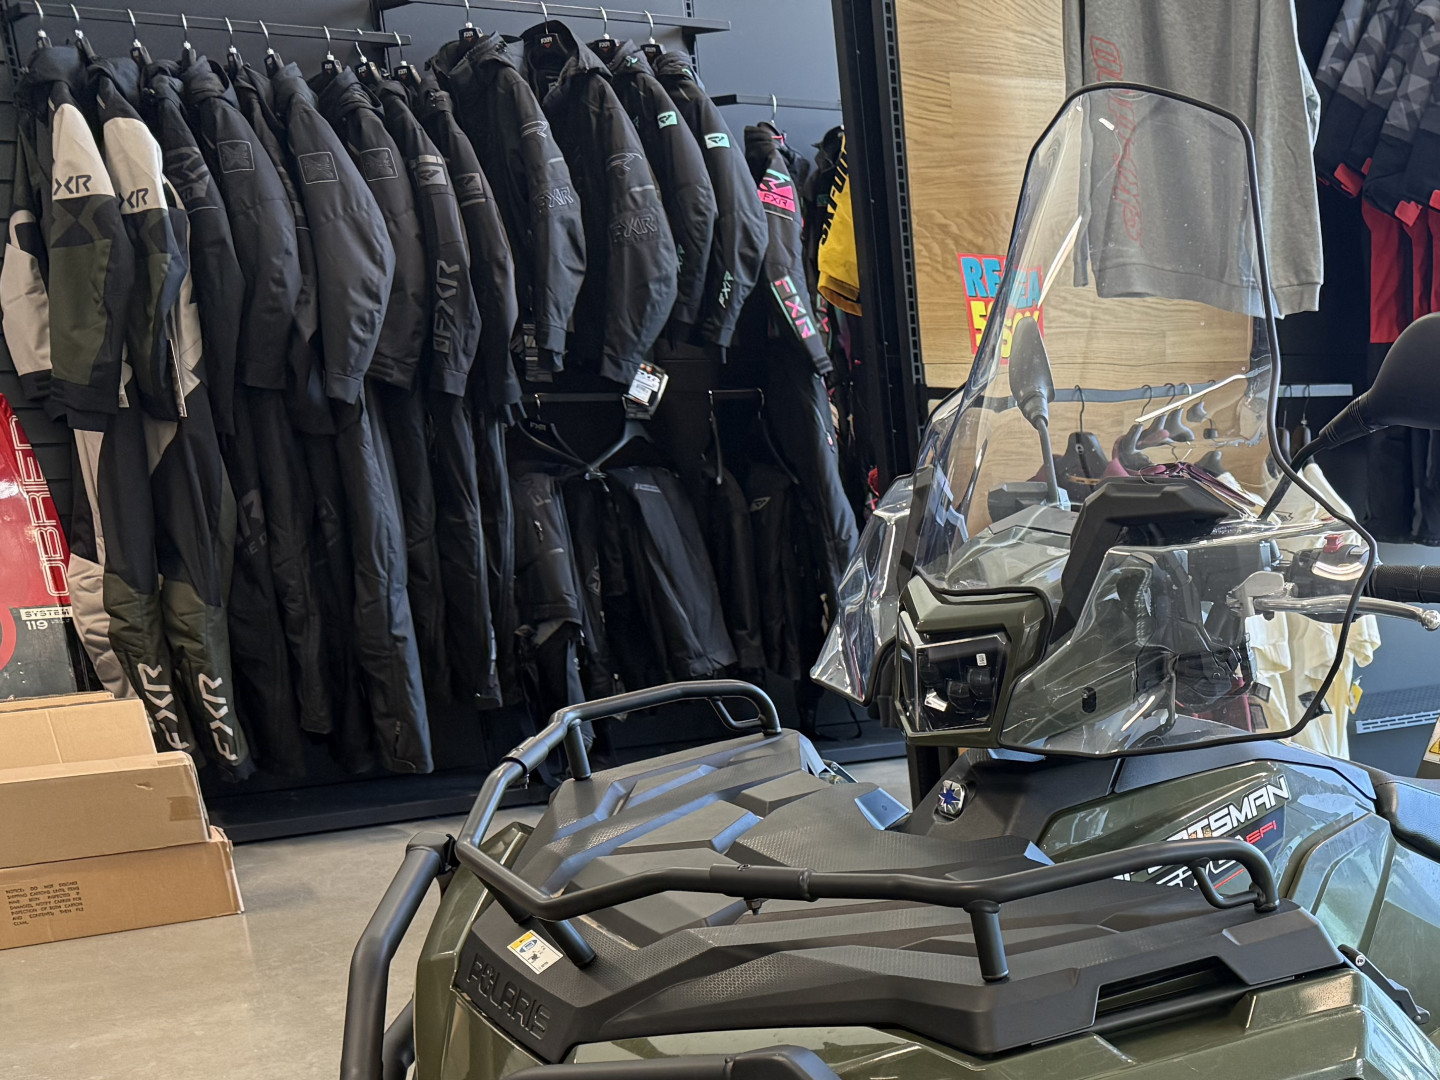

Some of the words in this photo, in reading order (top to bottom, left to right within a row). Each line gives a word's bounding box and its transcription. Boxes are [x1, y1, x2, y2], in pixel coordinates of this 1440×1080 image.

[762, 192, 788, 209] FXR
[717, 270, 735, 309] FXR
[773, 275, 817, 340] FXR
[24, 608, 70, 618] SYSTEM
[26, 620, 48, 630] 119
[137, 662, 190, 750] FXR
[198, 673, 239, 761] FXR
[466, 953, 551, 1041] POLARIS
